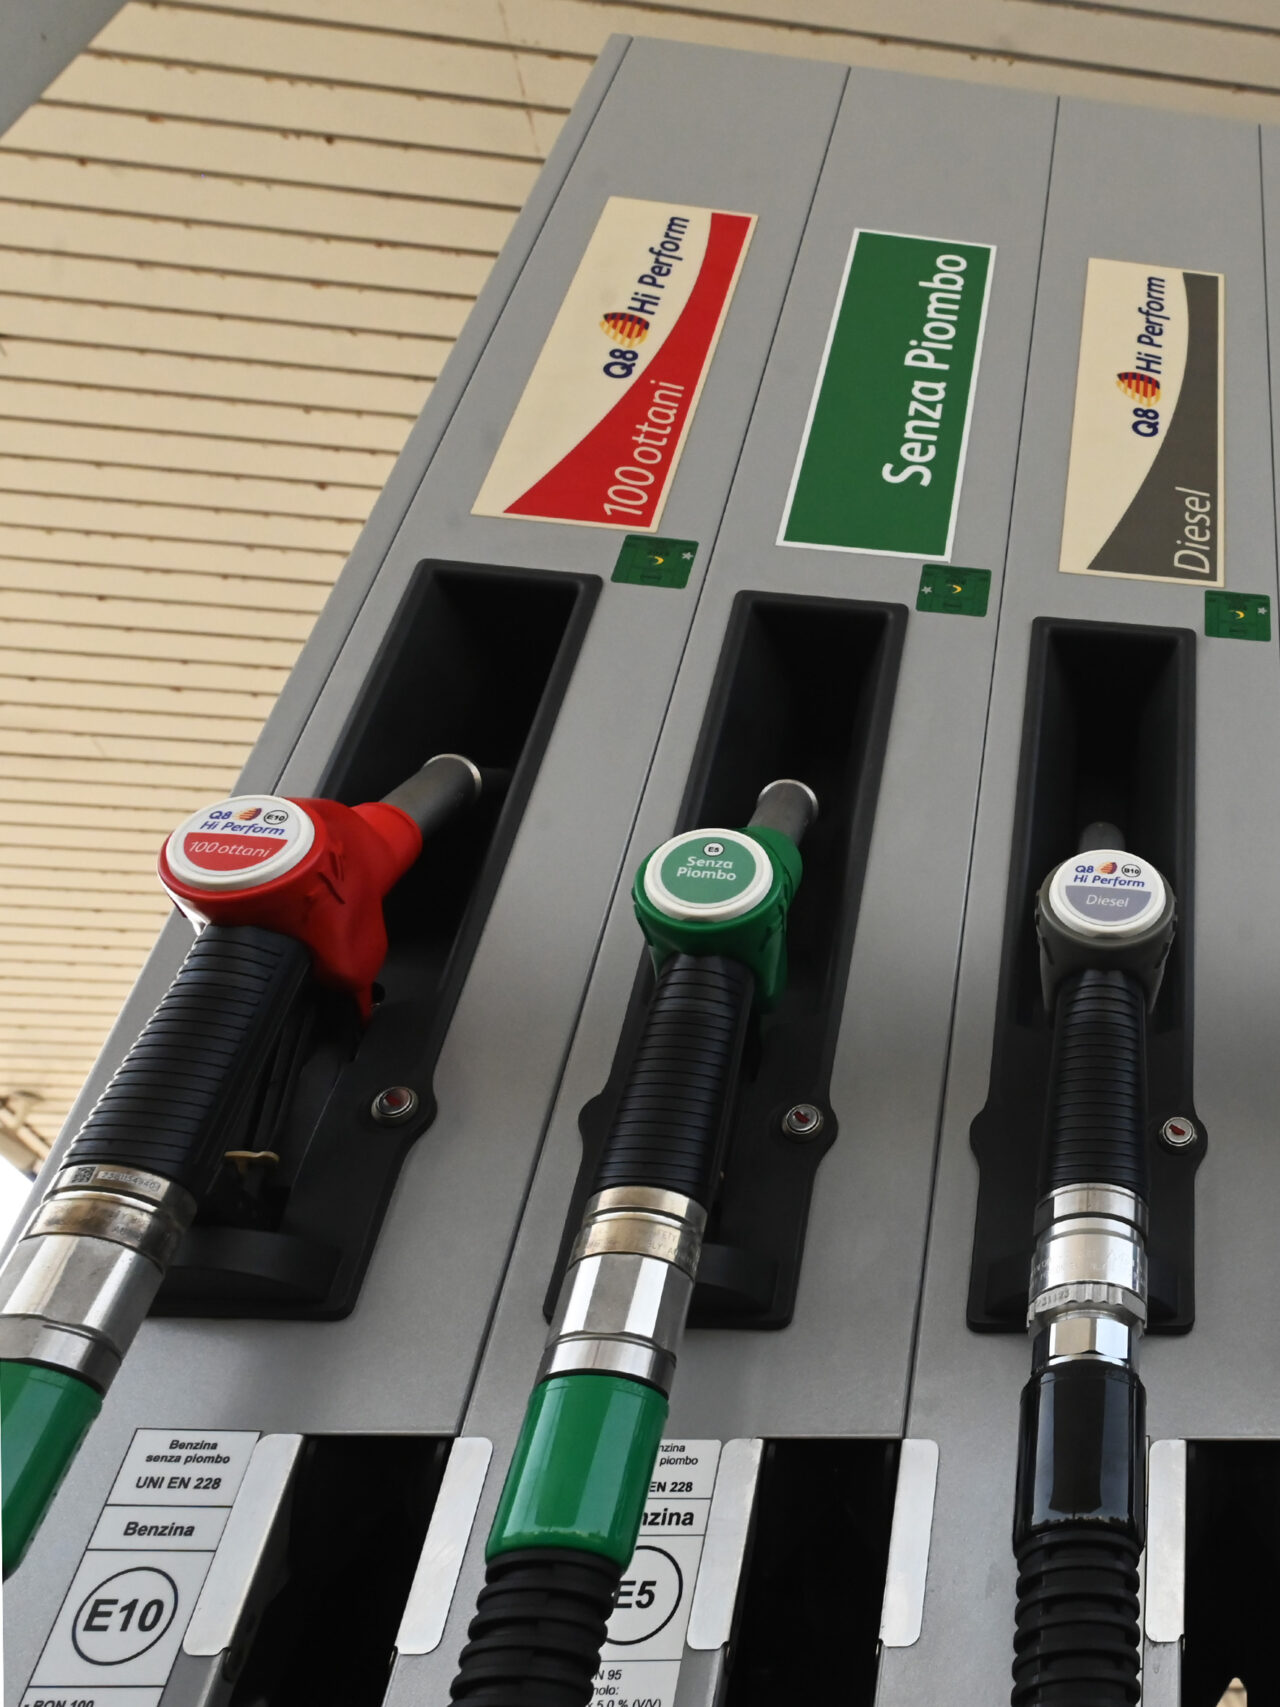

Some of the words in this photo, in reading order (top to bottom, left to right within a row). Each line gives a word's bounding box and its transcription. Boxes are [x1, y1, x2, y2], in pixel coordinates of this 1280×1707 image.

[638, 214, 690, 289] Perform
[627, 291, 662, 317] Hi
[903, 253, 968, 371] Piombo
[1137, 276, 1170, 348] Perform
[602, 348, 639, 380] Q8
[1136, 351, 1163, 375] Hi
[1131, 407, 1160, 438] Q8
[881, 381, 947, 487] Senza
[603, 465, 655, 517] 100
[631, 379, 685, 465] ottani
[1173, 486, 1211, 575] Diesel
[209, 810, 233, 820] Q8
[199, 820, 220, 831] Hi
[220, 821, 286, 836] Perform
[189, 841, 219, 853] 100
[218, 844, 272, 858] ottani
[686, 856, 733, 869] Senza
[1075, 865, 1094, 873] Q8
[676, 866, 737, 881] Piombo
[1073, 874, 1088, 884] Hi
[1092, 875, 1145, 888] Perform
[1086, 894, 1130, 908] Diesel
[169, 1439, 218, 1451] Benzina
[659, 1443, 686, 1453] nzina
[145, 1454, 181, 1464] senza
[183, 1453, 230, 1465] piombo
[659, 1456, 699, 1467] piombo
[135, 1476, 165, 1489] UNI
[167, 1477, 191, 1489] EN
[193, 1477, 222, 1490] 228
[669, 1481, 693, 1493] 228
[642, 1507, 695, 1527] zina
[123, 1521, 195, 1537] Benzina
[614, 1580, 657, 1609] E5
[82, 1598, 164, 1633] E10
[607, 1669, 623, 1681] 95
